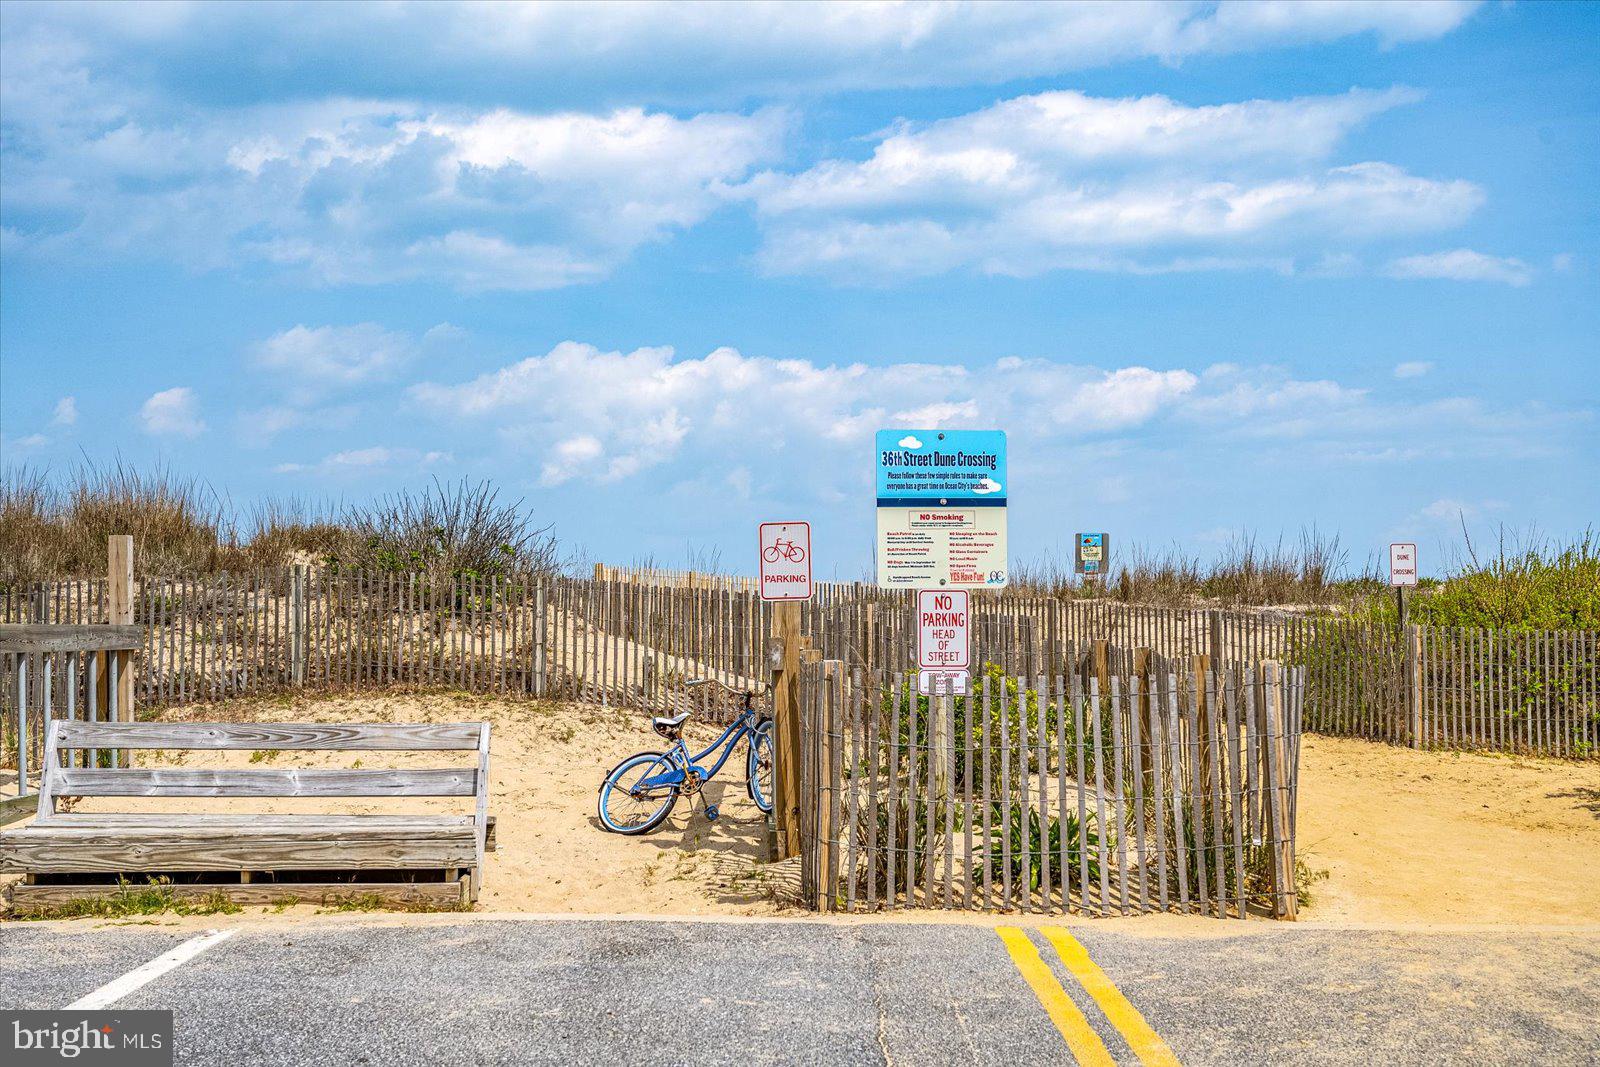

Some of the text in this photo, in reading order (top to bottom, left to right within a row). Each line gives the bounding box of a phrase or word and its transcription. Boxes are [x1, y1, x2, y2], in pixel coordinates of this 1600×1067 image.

[882, 451, 997, 471] 36th Street Dune Crossing
[936, 472, 949, 480] simple
[917, 483, 928, 491] great
[958, 482, 969, 491] City's
[765, 574, 806, 583] PARKING
[950, 572, 985, 581] YES Have Fun!
[935, 596, 952, 610] NO
[923, 613, 964, 627] PARKING
[932, 629, 955, 639] HEAD
[938, 640, 949, 650] OF
[928, 652, 960, 661] STREET
